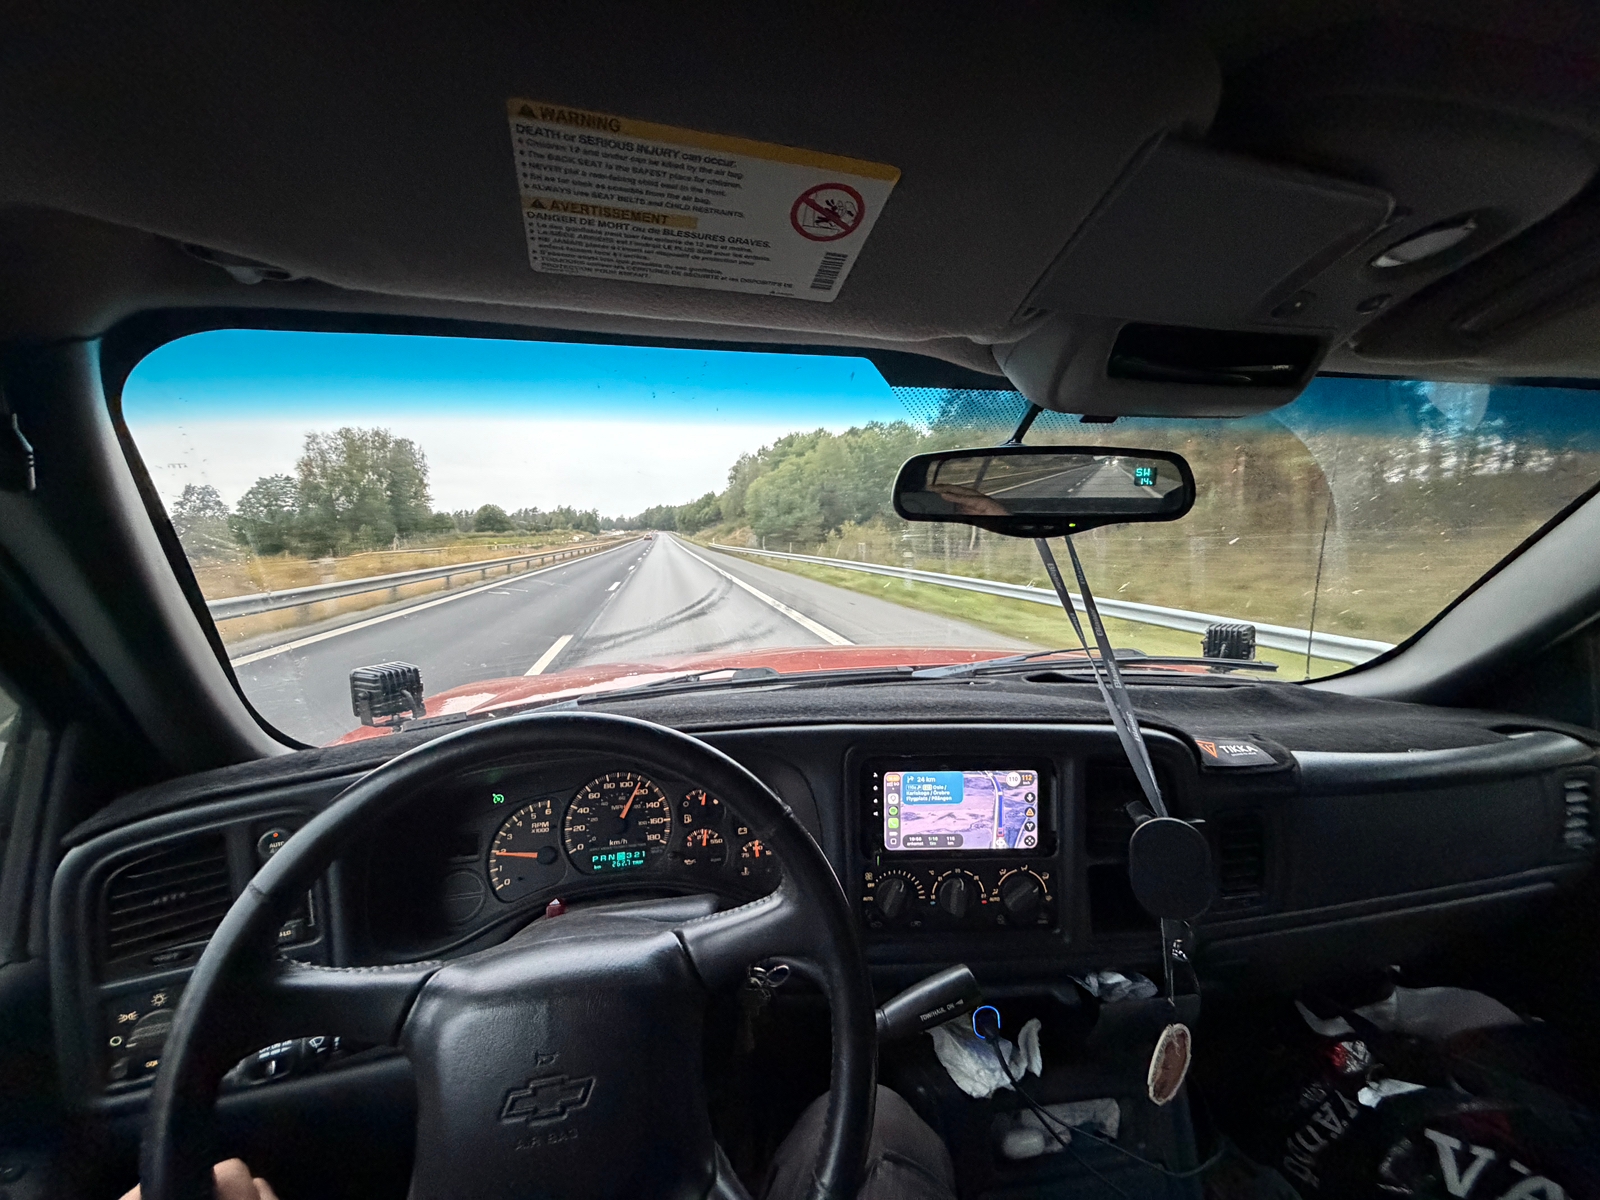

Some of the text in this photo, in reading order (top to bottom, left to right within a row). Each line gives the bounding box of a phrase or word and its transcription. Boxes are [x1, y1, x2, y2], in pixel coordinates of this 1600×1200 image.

[540, 106, 620, 132] WARNING
[516, 124, 560, 139] DEATH
[579, 135, 633, 151] SERIOUS
[637, 143, 680, 158] INJURY
[682, 153, 702, 162] can
[528, 150, 544, 158] The
[547, 154, 575, 164] BACK
[578, 158, 602, 168] SEAT
[632, 166, 666, 177] SAFEST
[529, 162, 561, 172] NEVER
[532, 184, 571, 194] ALWAYS
[592, 192, 614, 200] SEAT
[617, 196, 645, 205] BELTS
[665, 202, 690, 210] CHILD
[551, 200, 668, 225] AVERTISSEMENT
[527, 211, 576, 224] DANGER
[598, 220, 630, 231] MORT
[662, 229, 725, 242] BLESSURES
[1136, 468, 1150, 476] SW
[1219, 744, 1258, 753] TIKKA
